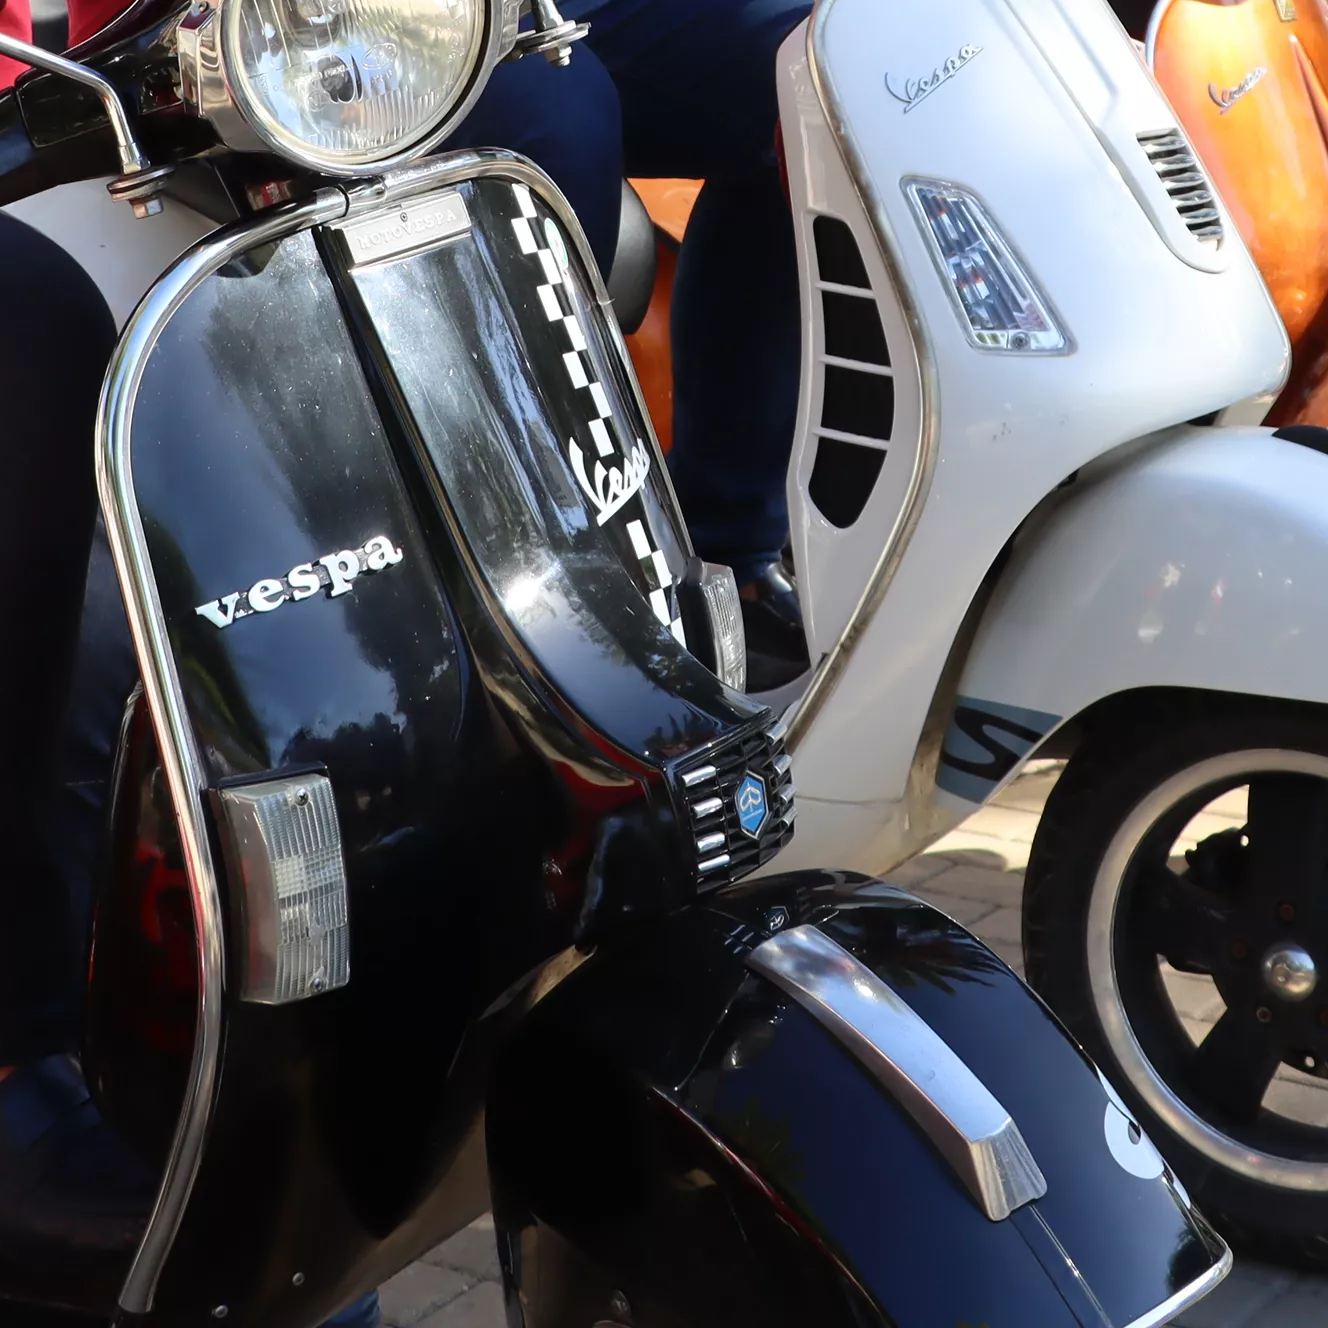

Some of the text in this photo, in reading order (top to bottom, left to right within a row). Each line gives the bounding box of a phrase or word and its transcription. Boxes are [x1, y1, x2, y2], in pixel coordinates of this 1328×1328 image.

[884, 43, 984, 114] Vespa
[357, 208, 457, 250] MOTOVESPA
[194, 535, 404, 629] vespa
